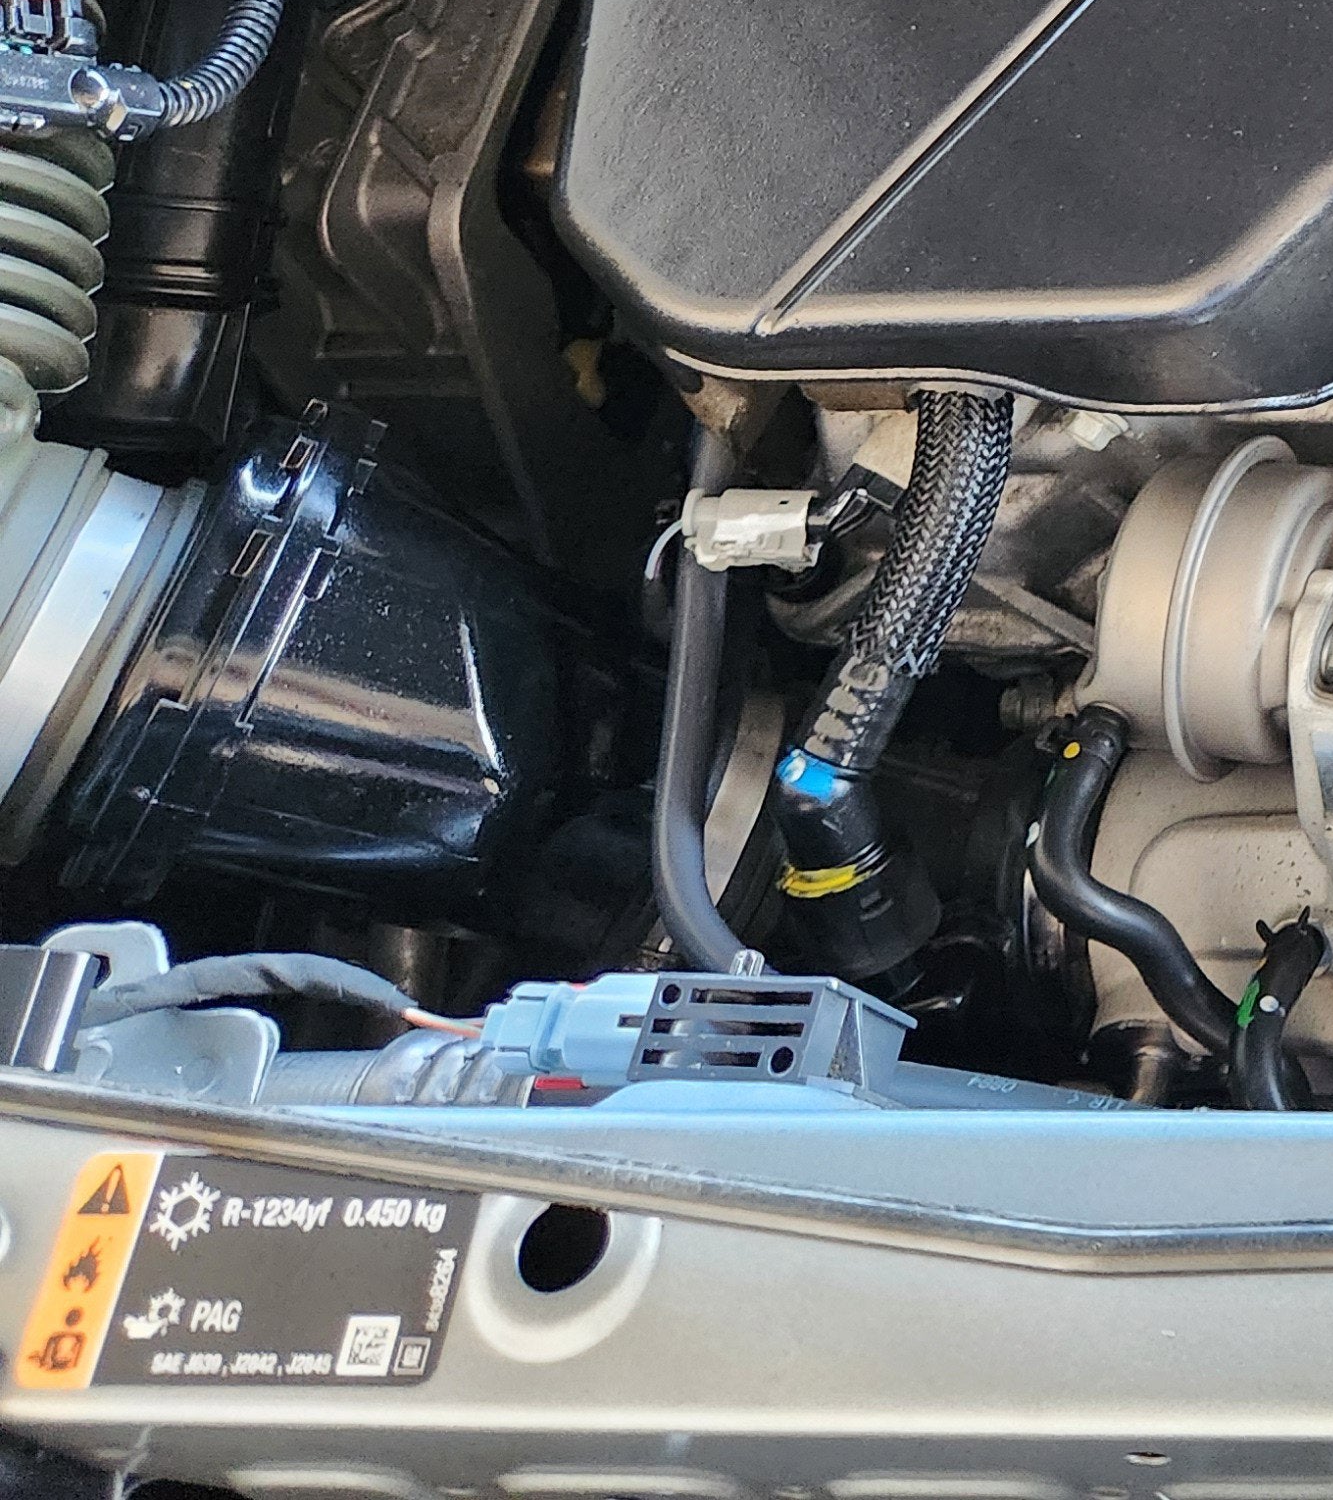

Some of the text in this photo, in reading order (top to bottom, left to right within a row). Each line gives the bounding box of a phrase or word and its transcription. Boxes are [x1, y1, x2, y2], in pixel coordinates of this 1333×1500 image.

[222, 1197, 447, 1233] R-1234yf 0.450 kg
[190, 1299, 242, 1332] PAG
[151, 1352, 186, 1374] SAE
